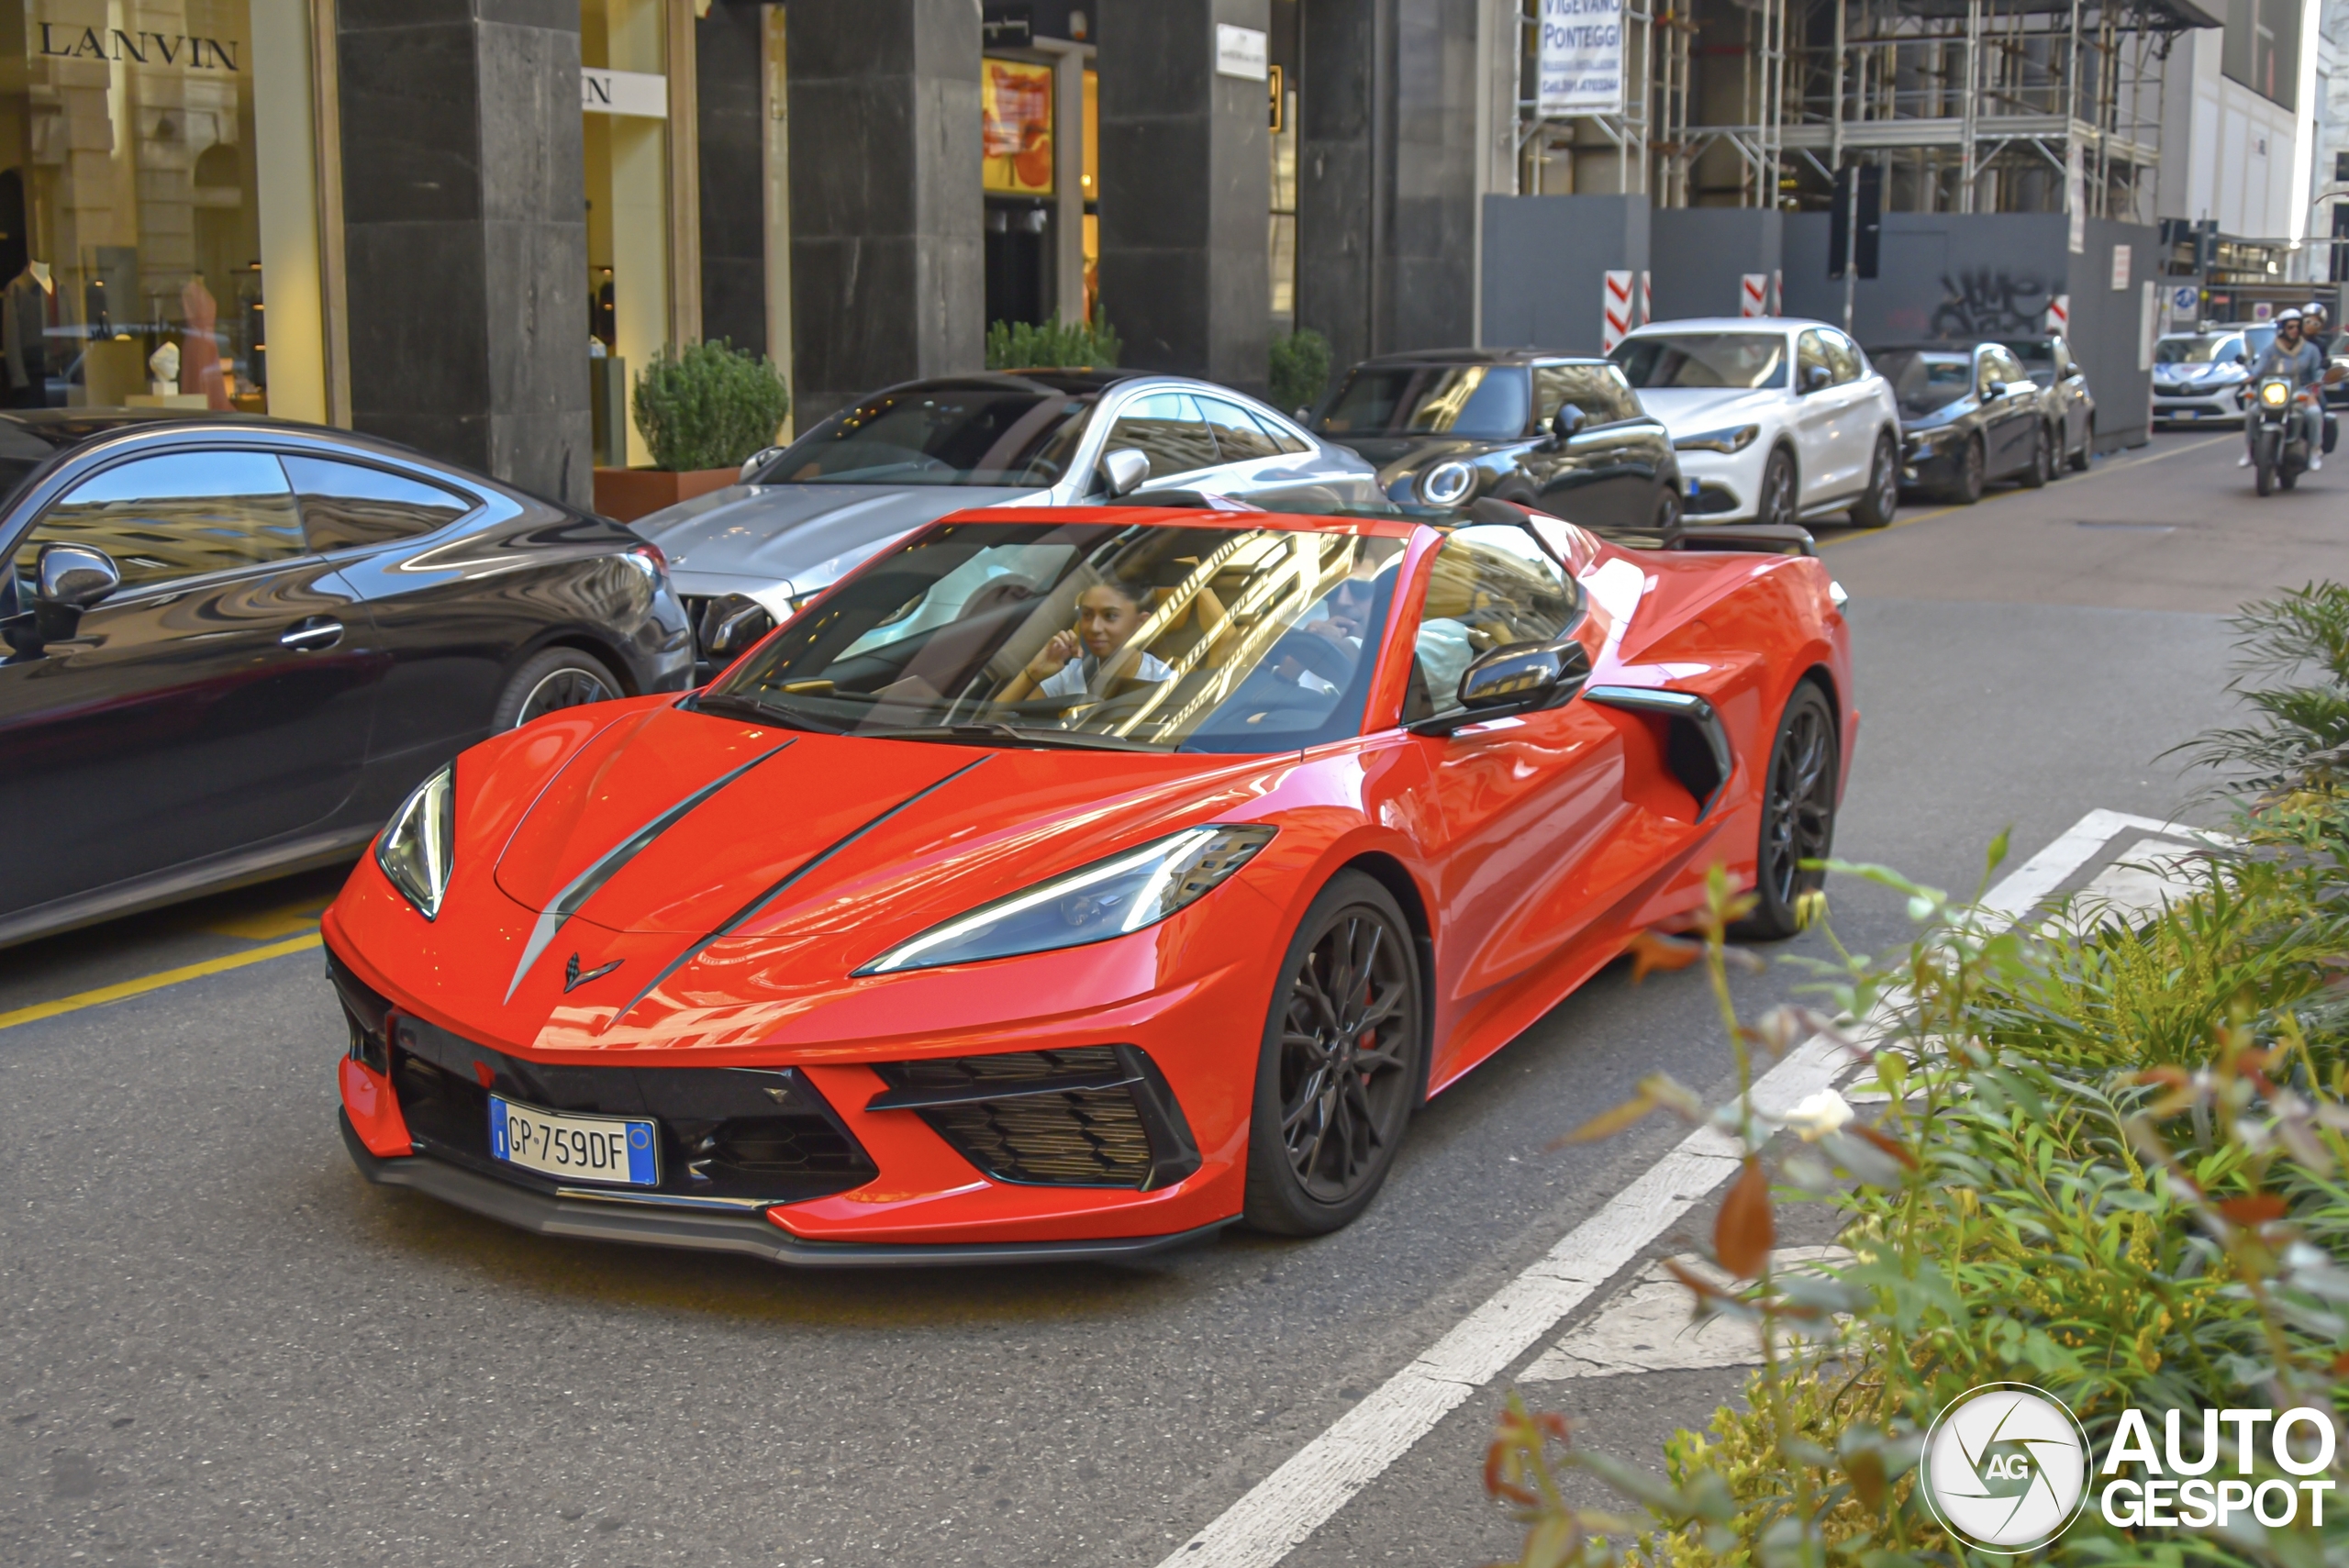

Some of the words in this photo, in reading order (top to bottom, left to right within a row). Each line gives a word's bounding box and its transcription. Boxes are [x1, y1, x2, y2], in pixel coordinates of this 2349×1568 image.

[38, 21, 239, 72] LANVIN
[1544, 22, 1621, 49] PONTEGGI
[582, 75, 611, 104] N
